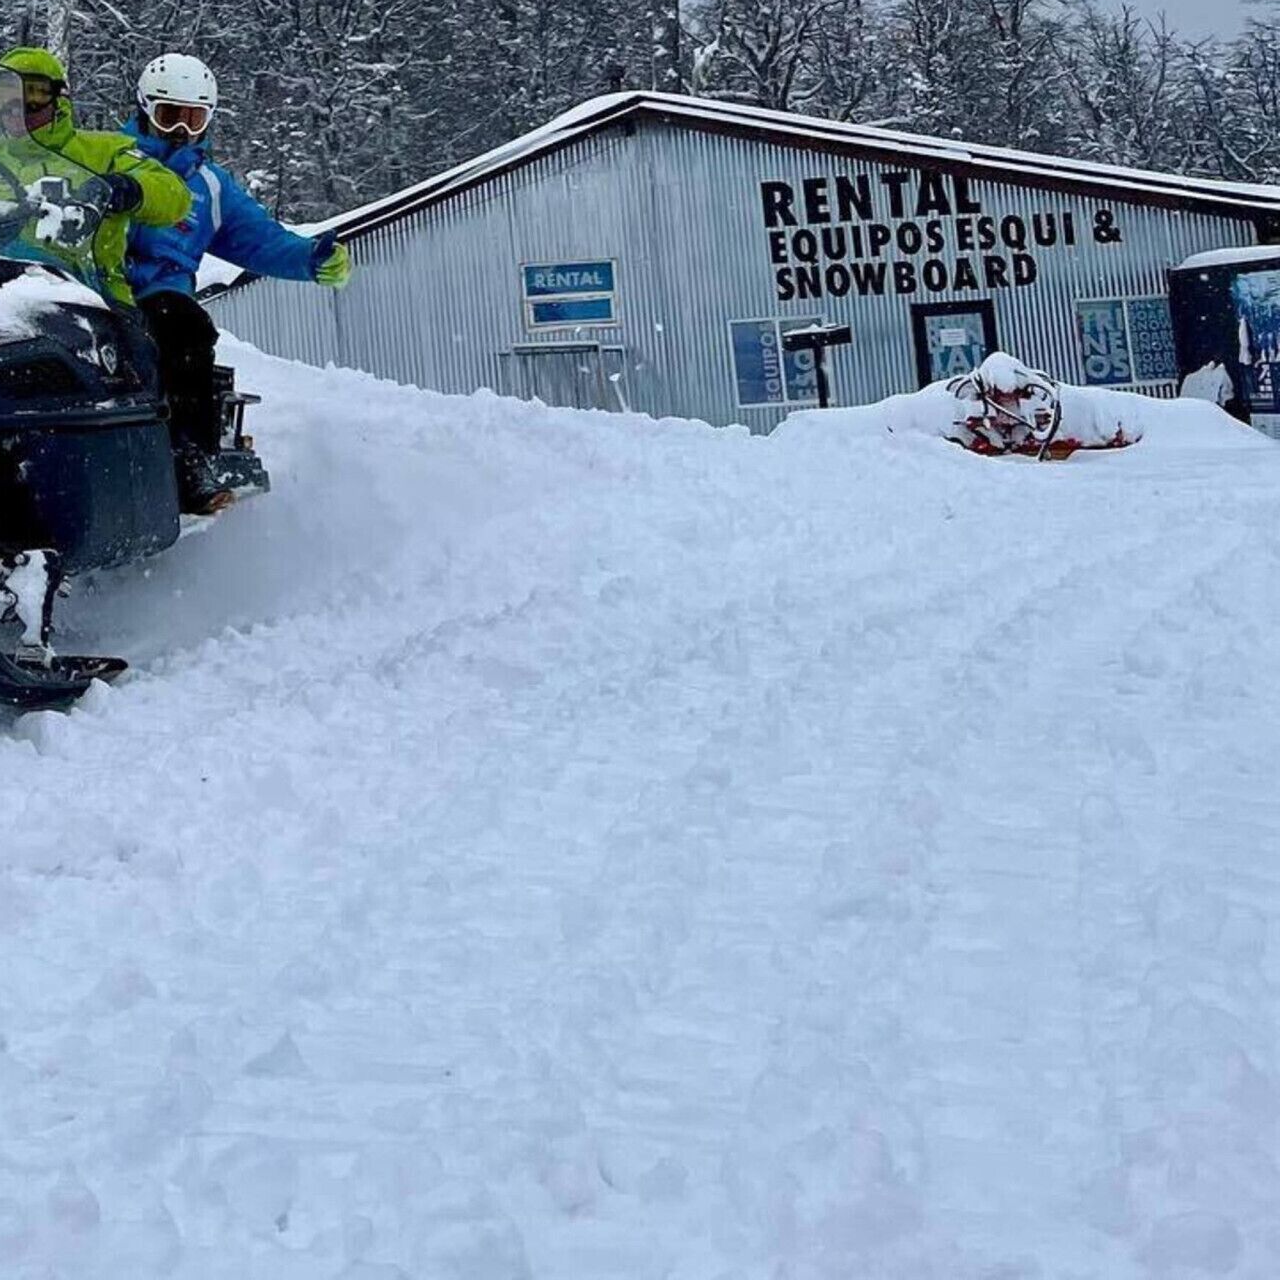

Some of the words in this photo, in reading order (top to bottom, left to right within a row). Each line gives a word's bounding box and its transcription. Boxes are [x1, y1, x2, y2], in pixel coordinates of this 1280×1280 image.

[761, 170, 981, 228] RENTAL
[770, 219, 945, 266] EQUIPOS
[956, 211, 1076, 252] ESQUI
[1093, 209, 1122, 244] &
[534, 271, 603, 288] RENTAL
[776, 253, 1038, 301] SNOWBOARD
